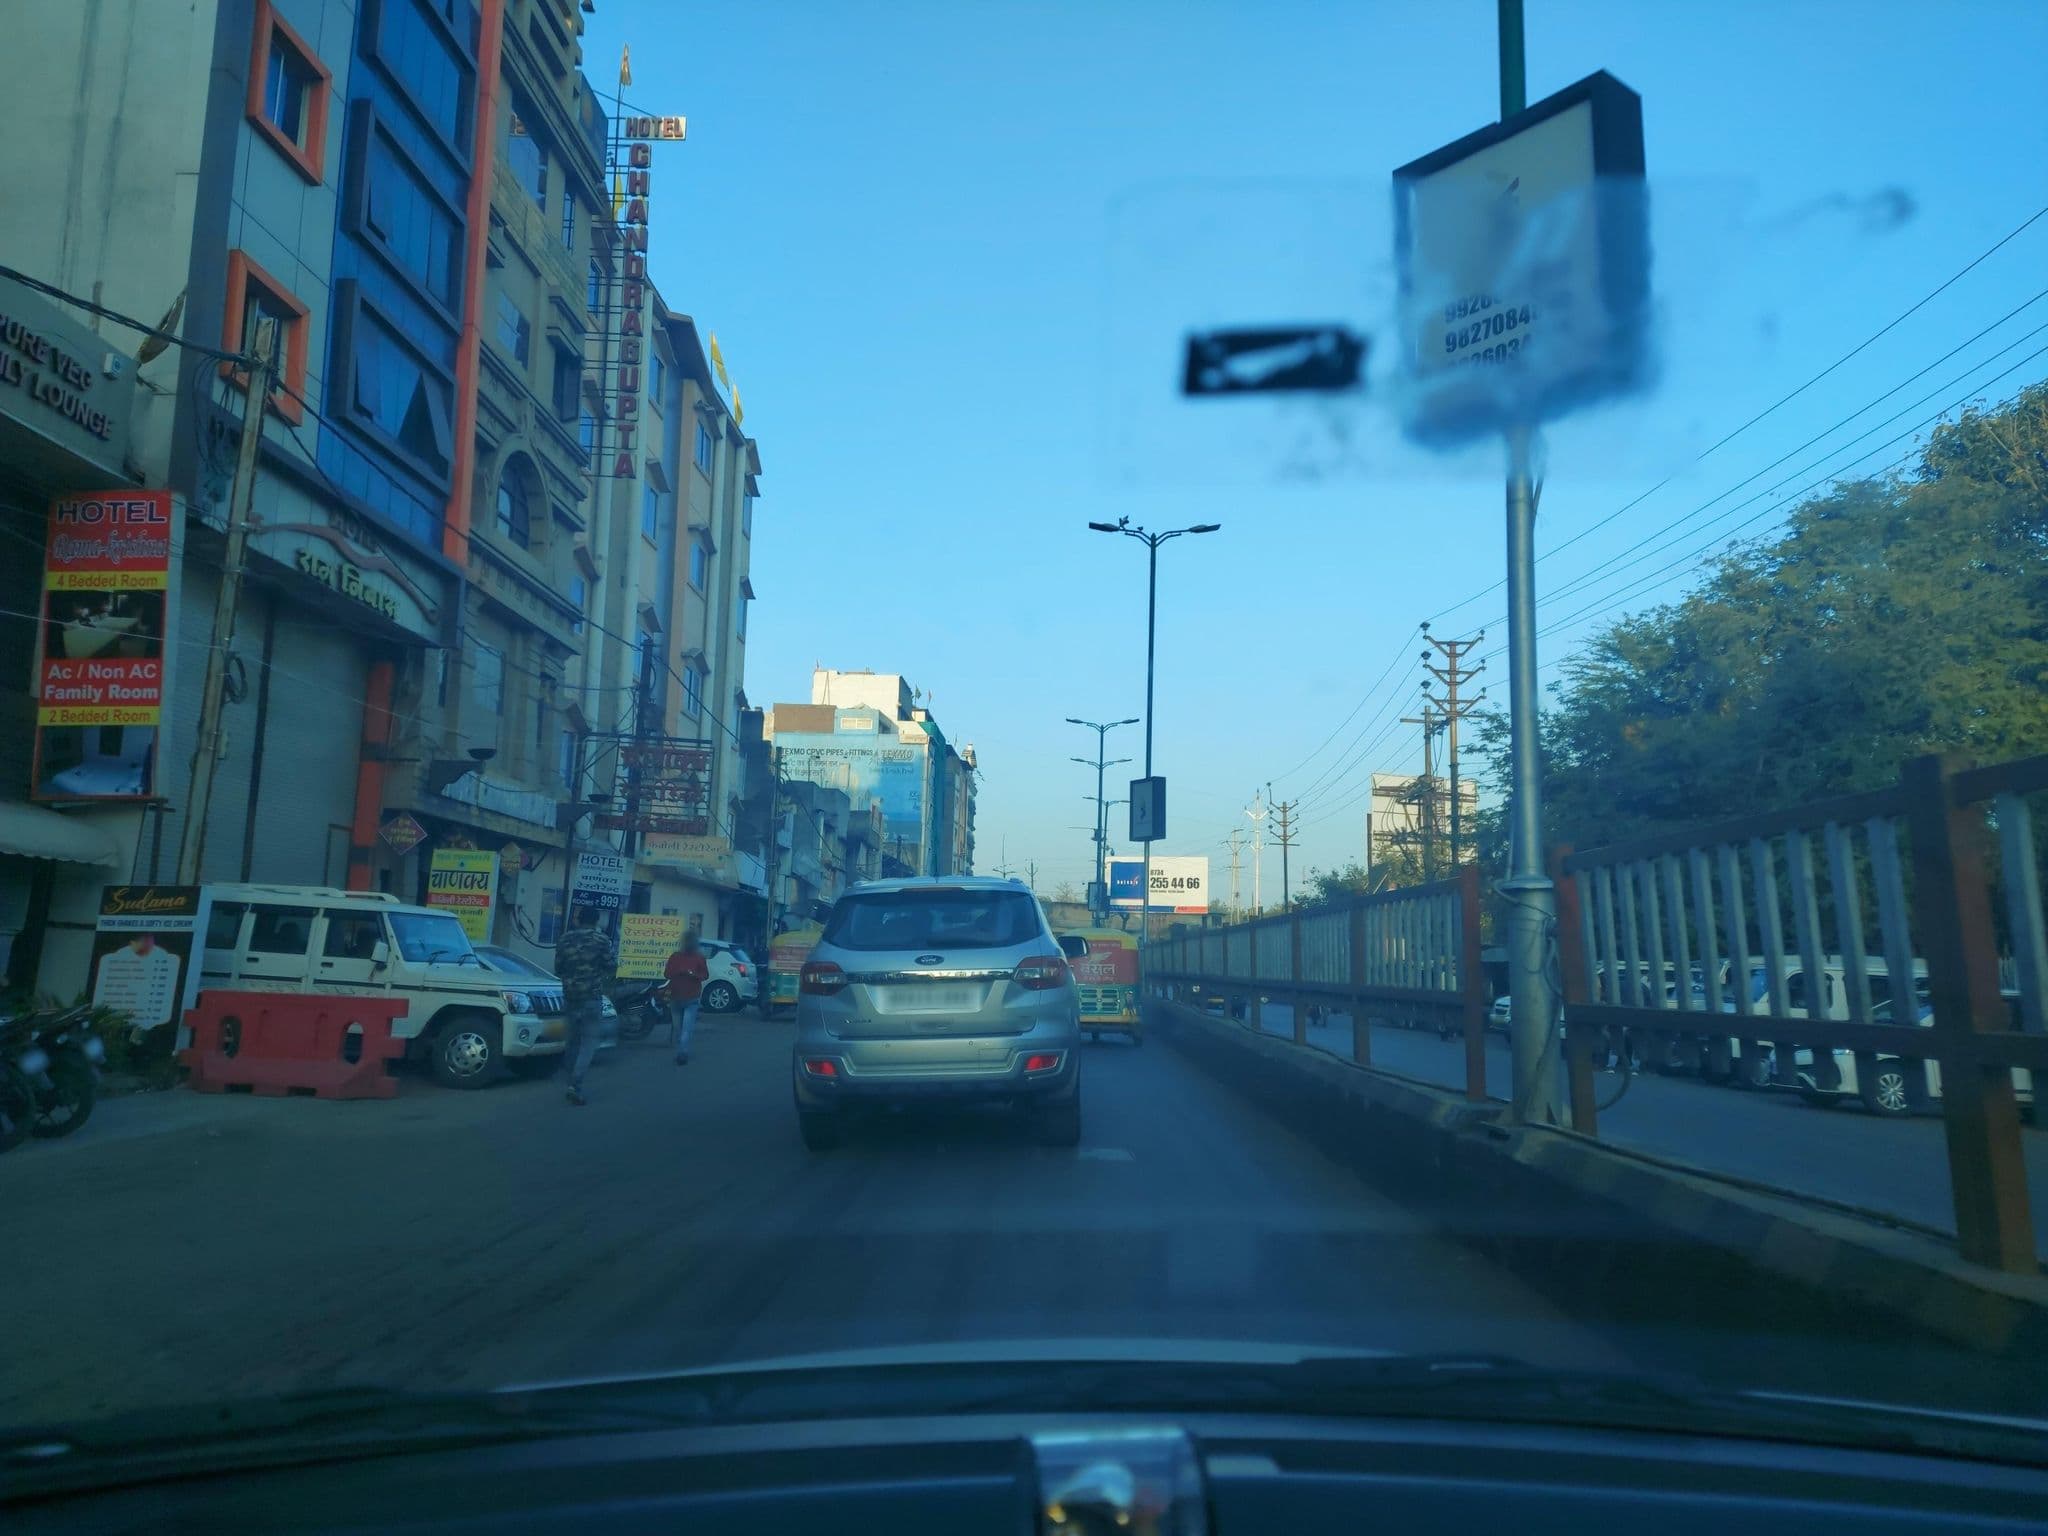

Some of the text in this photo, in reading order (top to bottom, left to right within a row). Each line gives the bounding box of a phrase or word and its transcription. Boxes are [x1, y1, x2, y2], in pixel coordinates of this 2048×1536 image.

[626, 117, 684, 138] HOTEL
[615, 143, 650, 478] CHANDRAGUPTA
[51, 347, 91, 391] VEG
[31, 373, 113, 440] LOUNGE
[56, 499, 168, 525] HOTEL
[57, 574, 158, 587] 4 Bedded Room
[48, 663, 157, 679] Ac / Non AC
[44, 684, 158, 703] Family Room
[49, 709, 151, 722] 2 Bedded Room
[826, 748, 844, 756] PIPES
[581, 854, 624, 869] HOTEL
[431, 869, 490, 890] चाणक्य
[1150, 877, 1169, 889] 255
[1171, 877, 1185, 888] 44
[1186, 877, 1200, 889] 66
[104, 888, 188, 914] Sudama
[600, 894, 619, 908] 999
